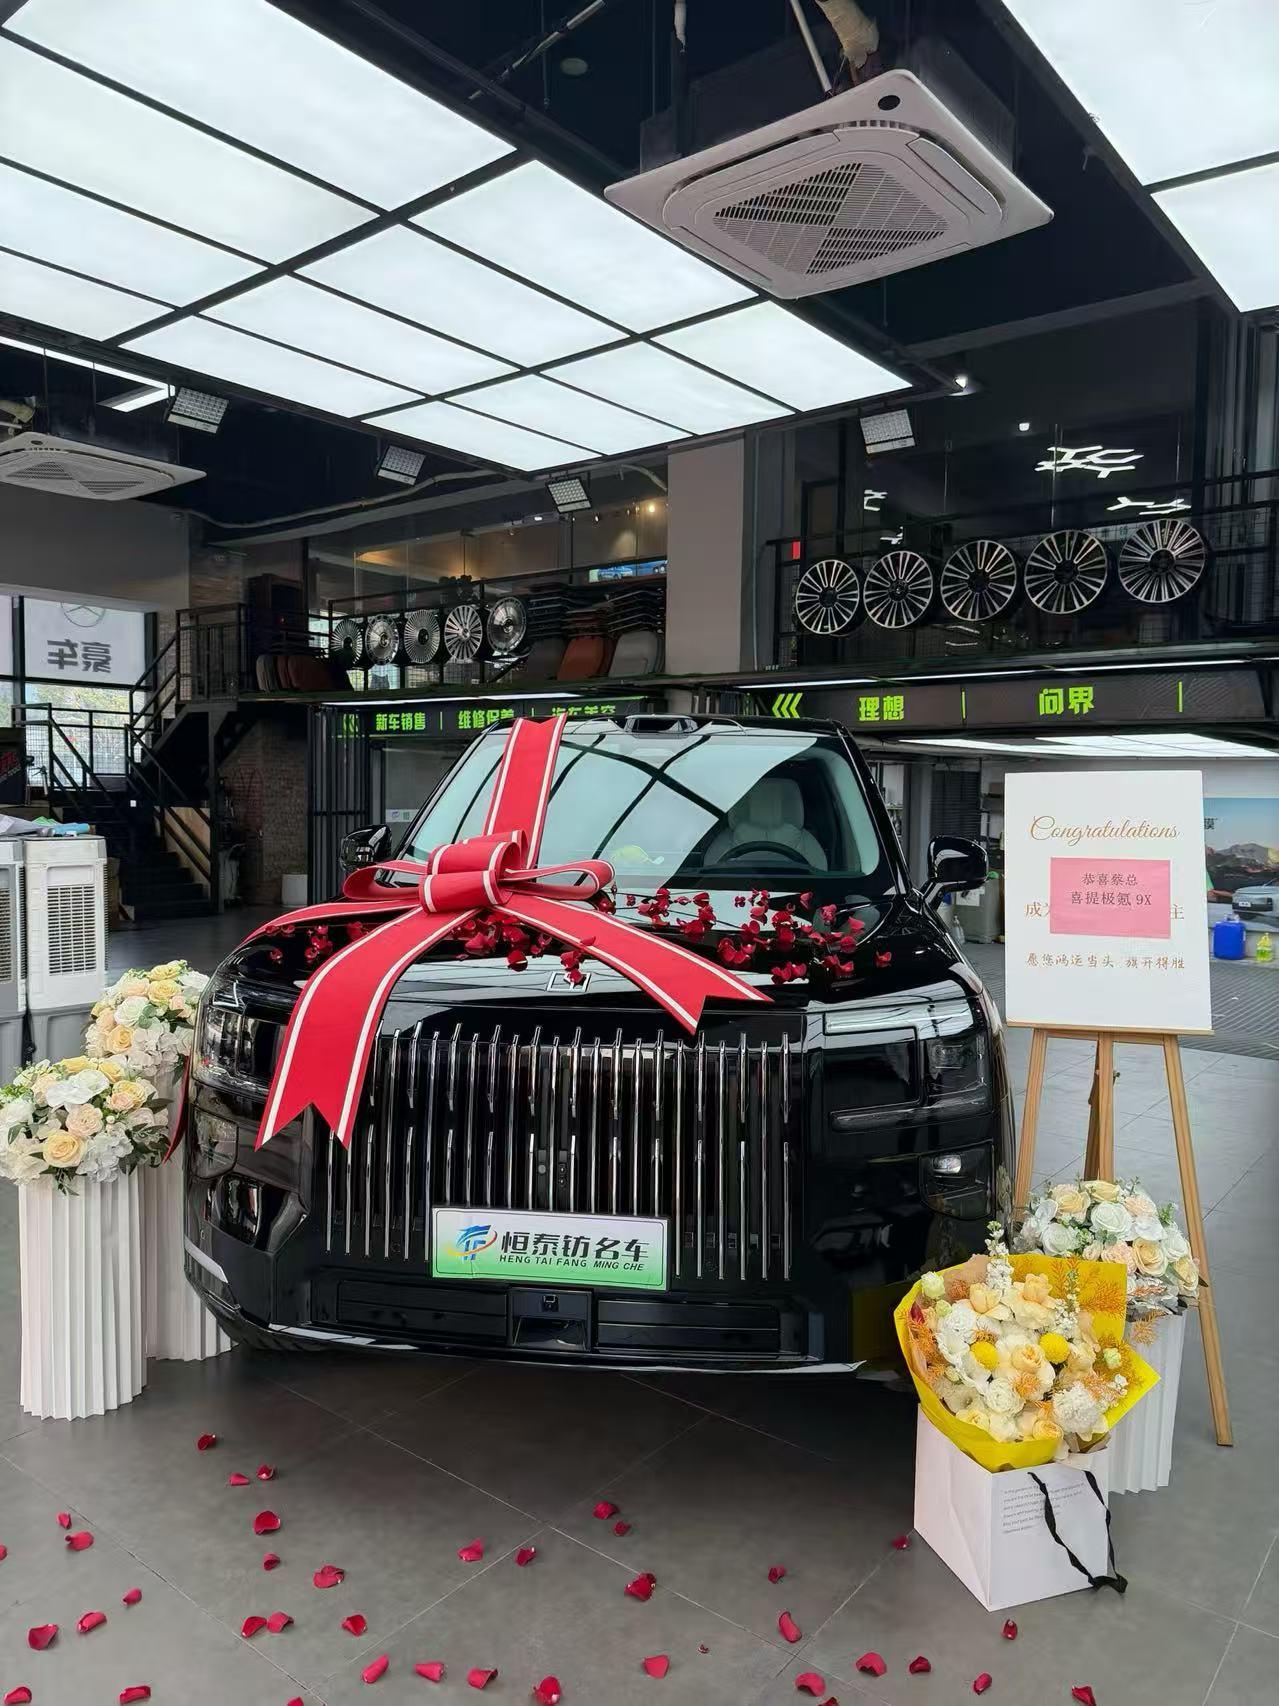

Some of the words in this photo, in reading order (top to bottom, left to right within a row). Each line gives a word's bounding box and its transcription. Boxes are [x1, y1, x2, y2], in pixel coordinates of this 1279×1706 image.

[858, 695, 904, 721] 理想
[1038, 686, 1094, 716] 问界
[376, 711, 426, 731] 新车销售
[1030, 815, 1180, 846] Congratulations
[1082, 873, 1138, 887] 恭喜蔡总
[1136, 894, 1152, 906] 9X
[1125, 956, 1184, 970] 旗开得胜
[499, 1254, 531, 1264] HENG
[536, 1256, 552, 1265] TAI
[556, 1257, 587, 1267] FANG
[593, 1260, 619, 1270] MING
[623, 1262, 644, 1272] CHE
